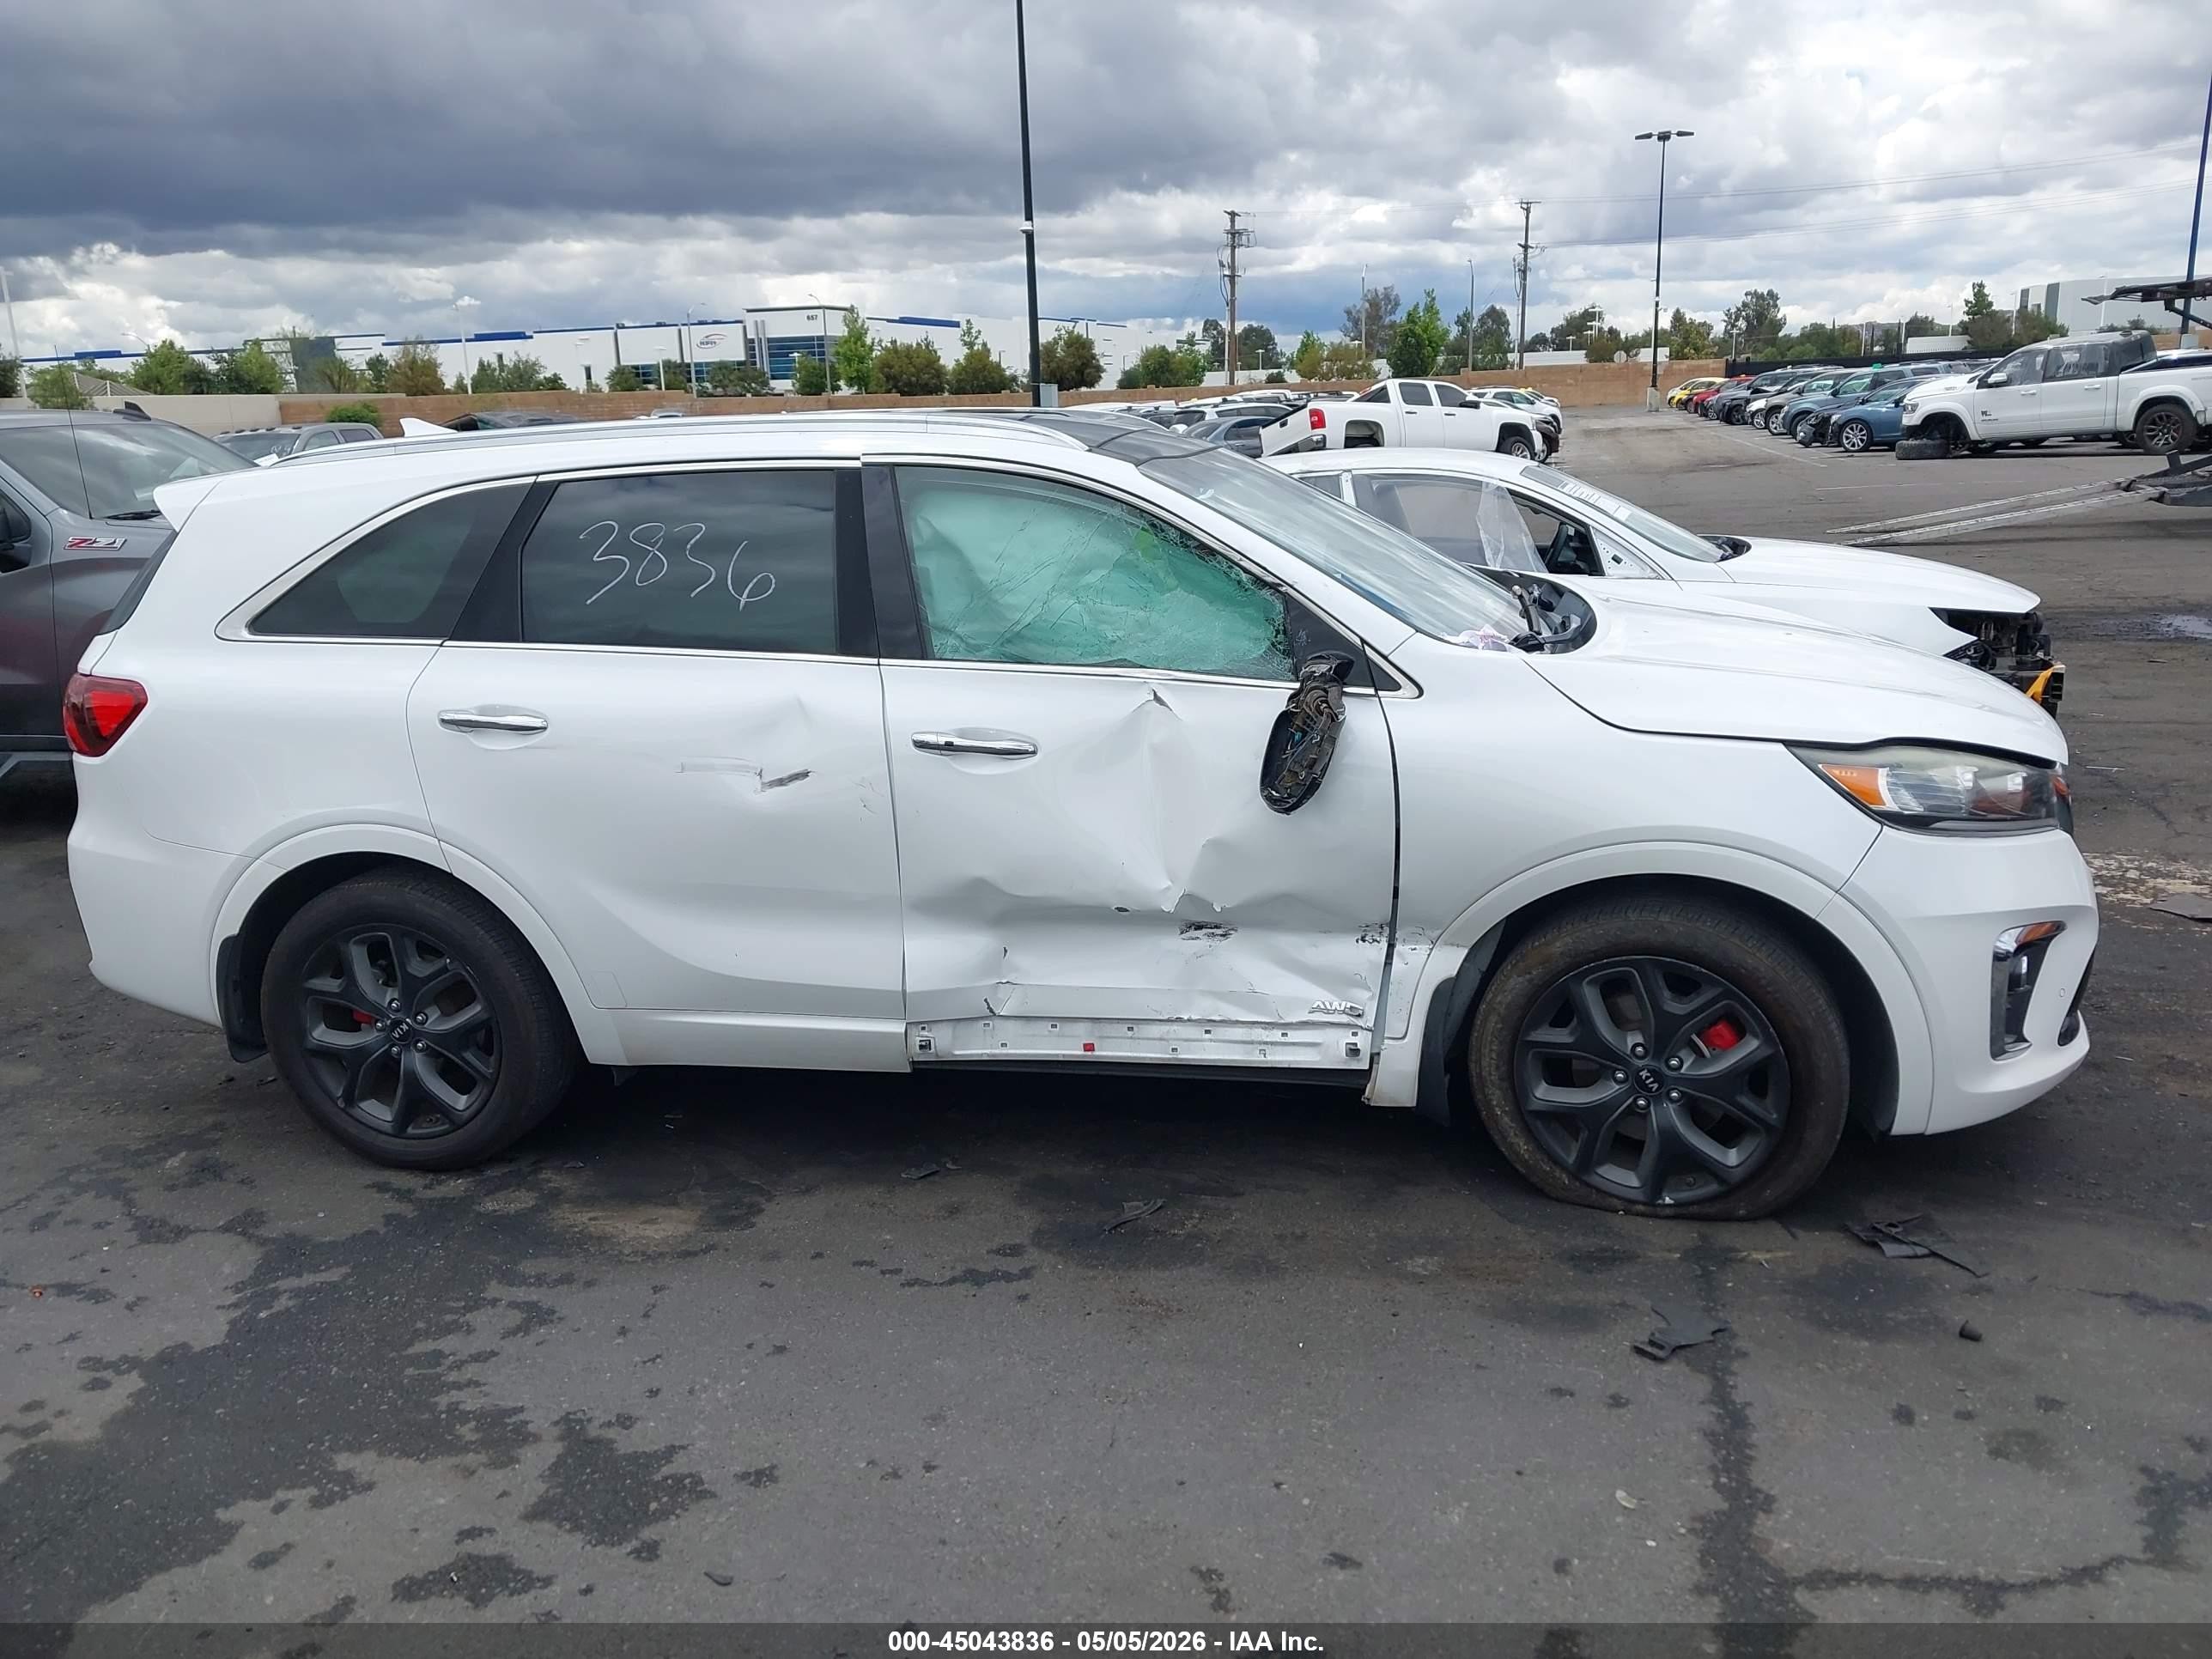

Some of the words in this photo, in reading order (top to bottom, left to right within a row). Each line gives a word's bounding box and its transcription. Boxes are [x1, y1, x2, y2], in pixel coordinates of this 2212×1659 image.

[64, 536, 127, 550] Z71
[579, 520, 775, 611] 3836
[1308, 1000, 1364, 1017] AWD
[1638, 1068, 1659, 1092] KIA
